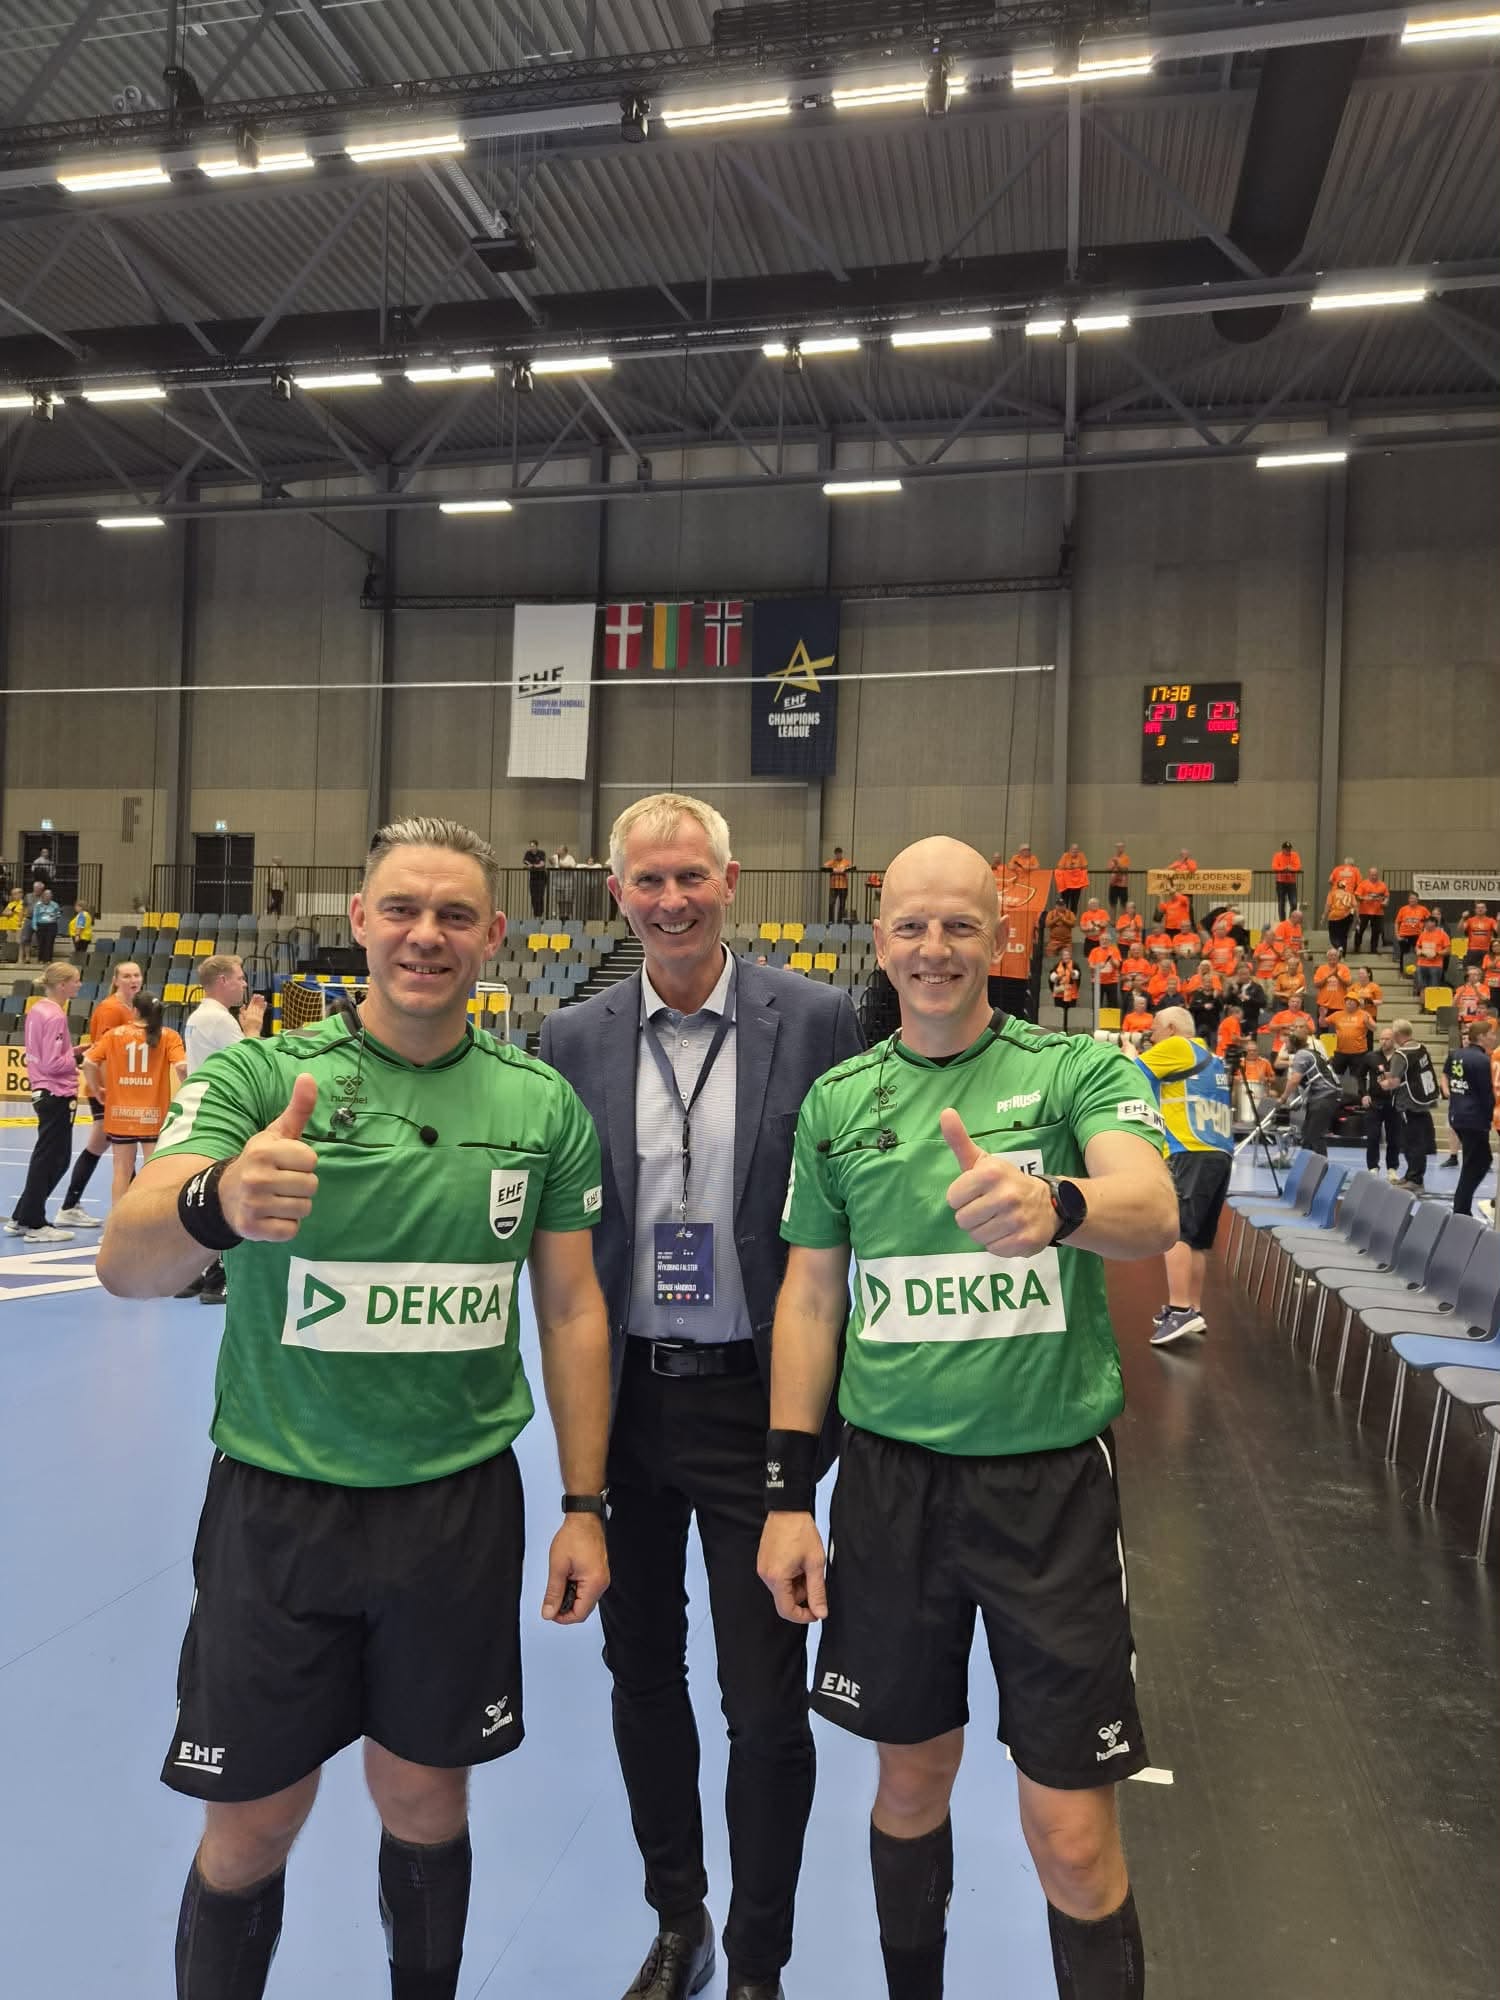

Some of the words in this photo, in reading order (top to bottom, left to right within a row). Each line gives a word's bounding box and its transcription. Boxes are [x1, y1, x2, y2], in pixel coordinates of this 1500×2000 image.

[518, 667, 564, 693] EHF
[784, 693, 807, 707] EHF
[1151, 685, 1191, 702] 17:38
[768, 712, 820, 726] CHAMPIONS
[778, 726, 810, 738] LEAGUE
[1417, 880, 1450, 891] TEAM
[1453, 879, 1500, 892] GRUND
[125, 1040, 149, 1073] 11
[498, 1181, 524, 1202] EHF
[587, 1191, 598, 1206] EHF
[905, 1269, 1051, 1317] DEKRA
[366, 1284, 502, 1325] DEKRA
[821, 1671, 861, 1698] EHF
[178, 1741, 226, 1765] EHF
